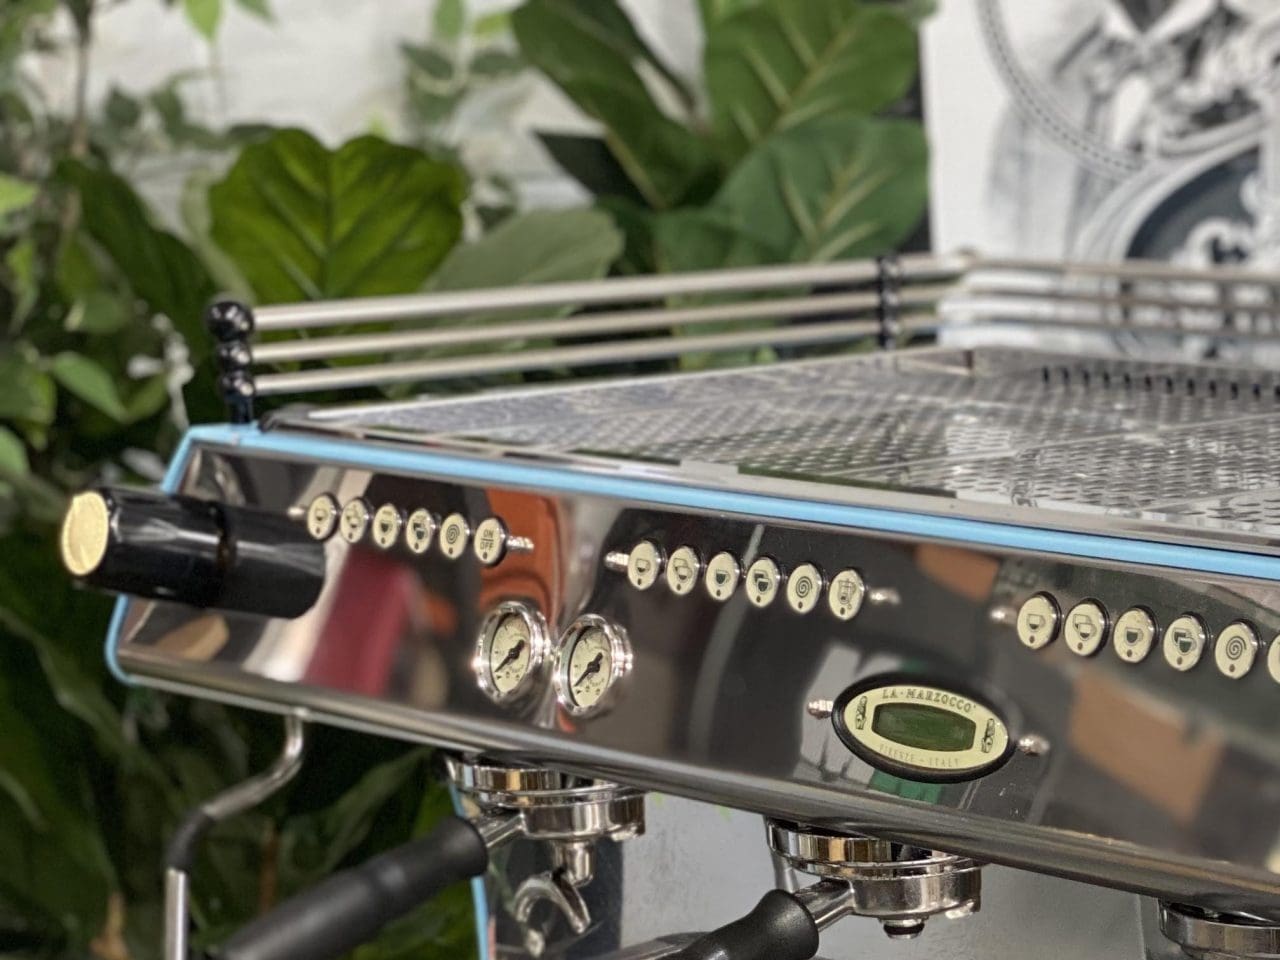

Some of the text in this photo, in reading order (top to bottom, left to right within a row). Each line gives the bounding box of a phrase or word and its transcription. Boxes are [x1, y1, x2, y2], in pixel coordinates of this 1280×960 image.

[480, 542, 494, 551] OFF
[882, 688, 972, 712] LA MARZOCCO
